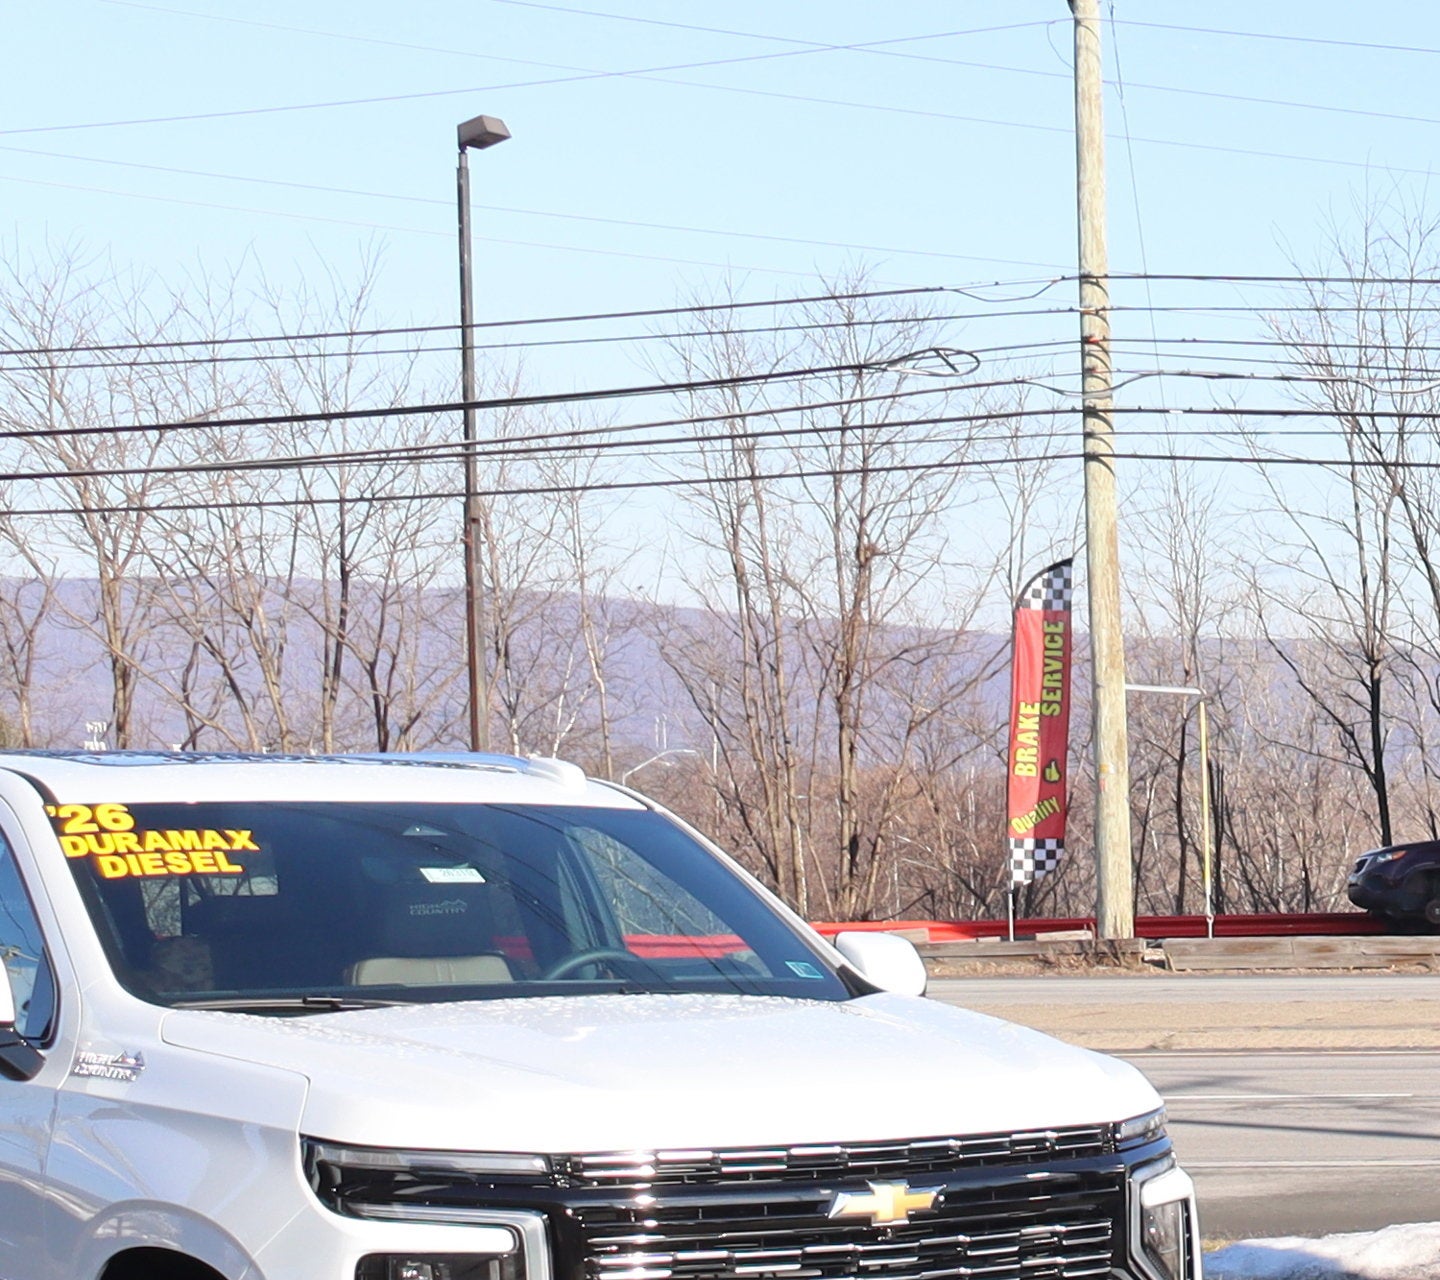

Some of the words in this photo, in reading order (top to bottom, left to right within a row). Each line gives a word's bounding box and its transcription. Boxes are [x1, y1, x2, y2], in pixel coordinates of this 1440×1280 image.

[1042, 620, 1065, 717] SERVICE
[1014, 701, 1041, 778] BRAKE
[1010, 795, 1061, 835] Quality
[59, 829, 261, 858] DURAMAX
[98, 850, 244, 879] DIESEL
